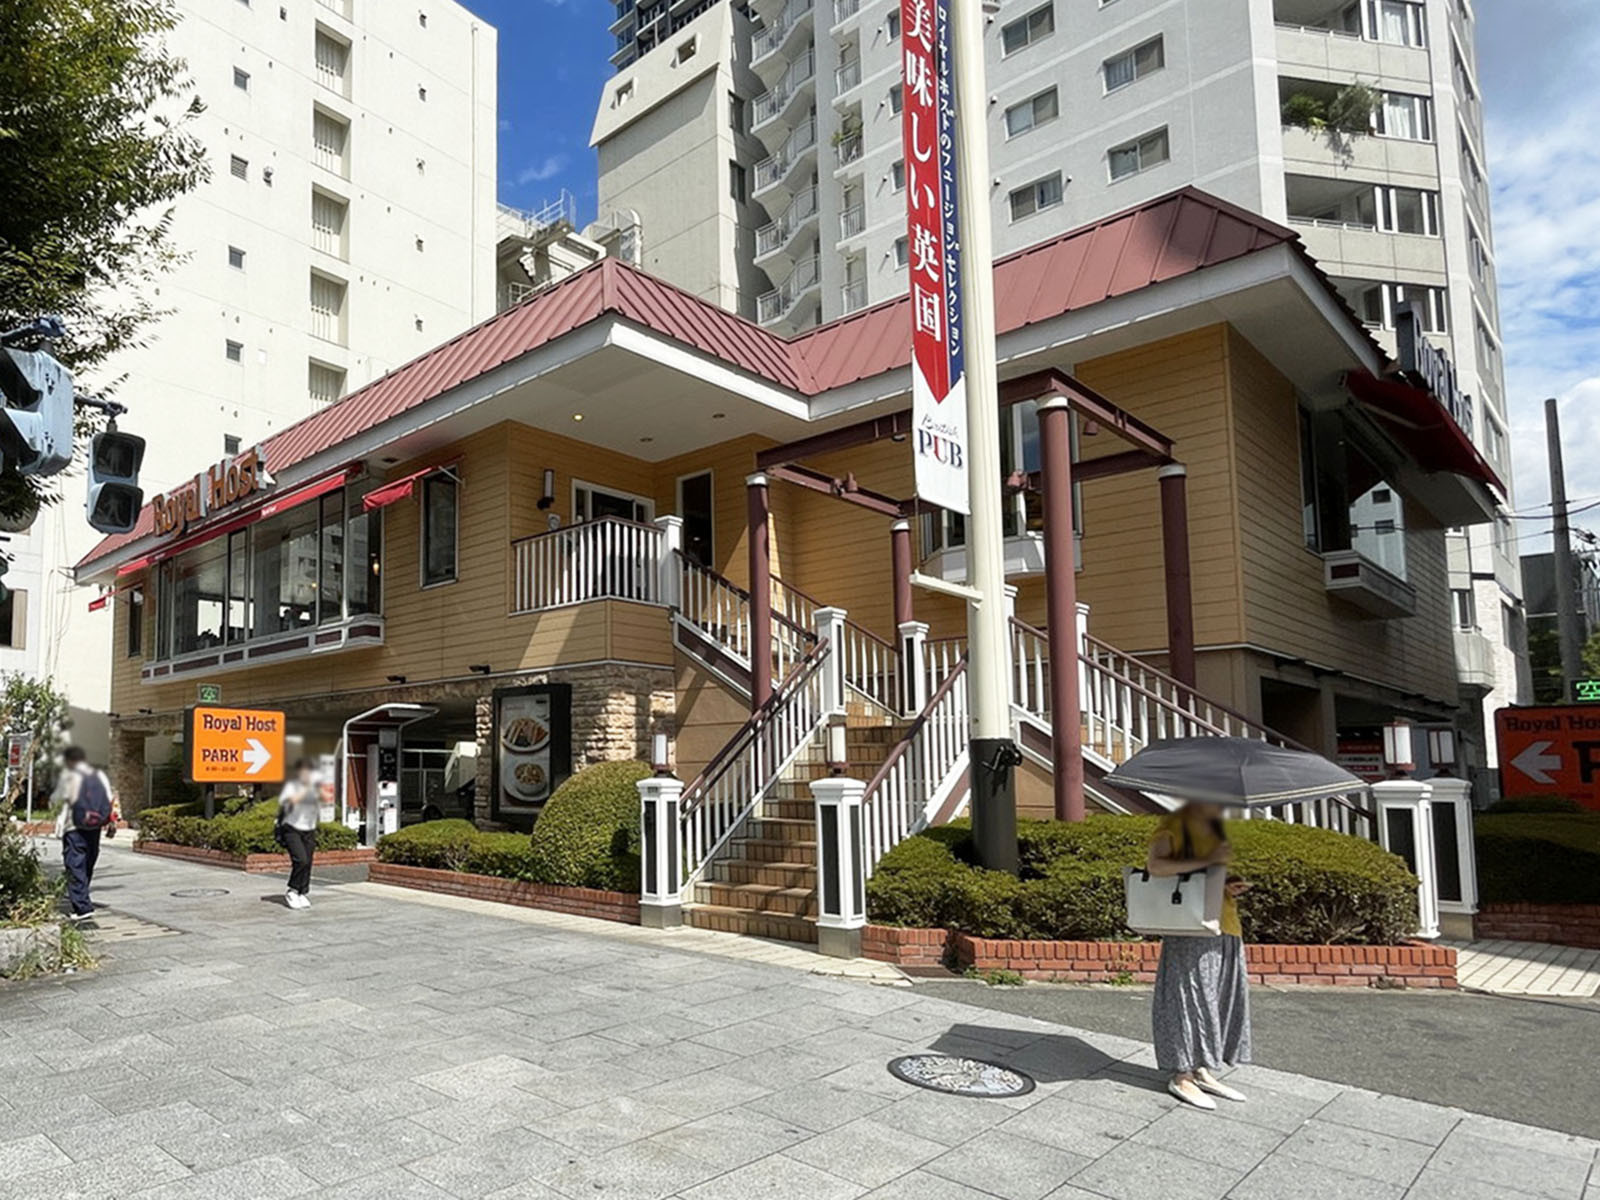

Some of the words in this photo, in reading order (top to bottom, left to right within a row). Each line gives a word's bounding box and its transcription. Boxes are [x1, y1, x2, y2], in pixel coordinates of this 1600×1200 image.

[905, 0, 941, 342] 美味しい英国
[918, 428, 963, 470] PUB
[152, 471, 206, 538] Royal
[207, 444, 267, 511] Host
[202, 714, 242, 733] Royal
[245, 716, 277, 732] Host
[1504, 714, 1560, 733] Royal
[1567, 714, 1600, 731] Ho
[202, 748, 239, 762] PARK
